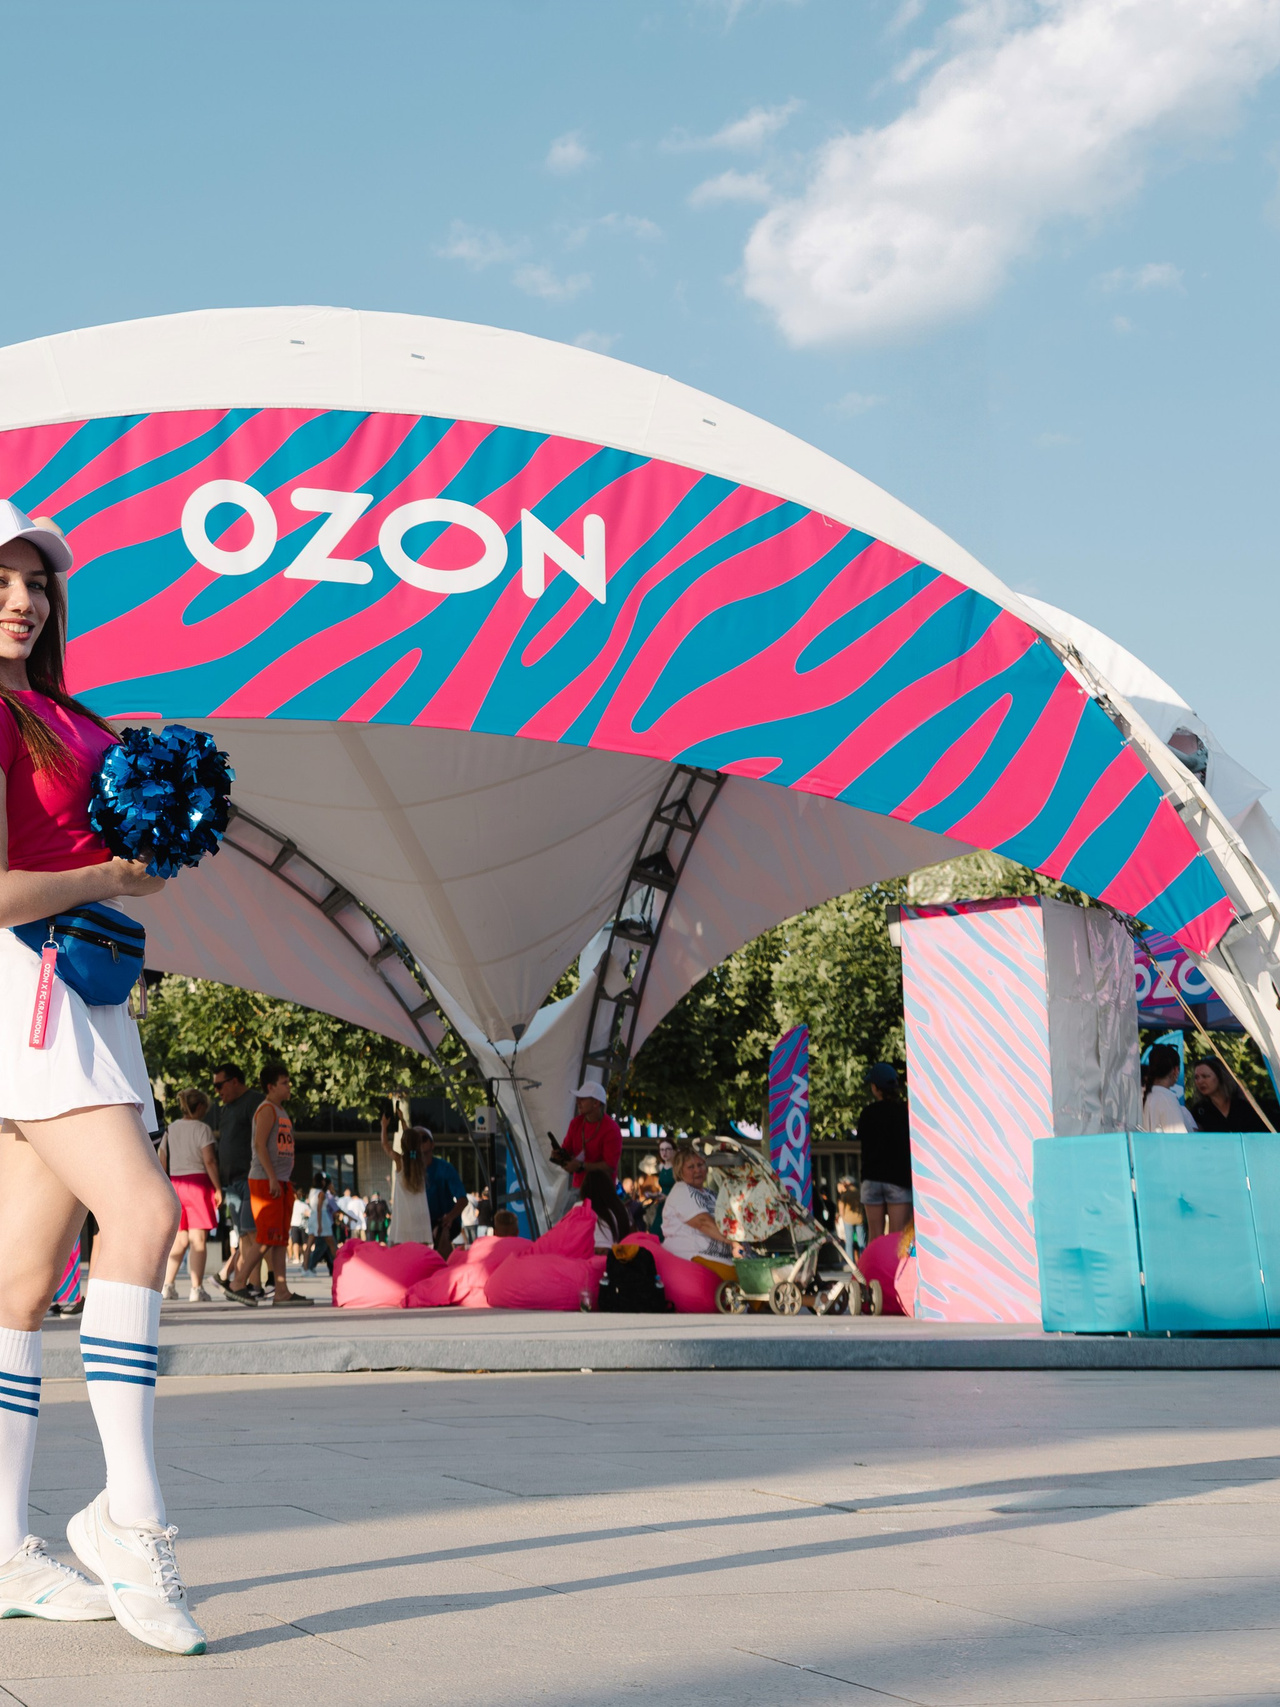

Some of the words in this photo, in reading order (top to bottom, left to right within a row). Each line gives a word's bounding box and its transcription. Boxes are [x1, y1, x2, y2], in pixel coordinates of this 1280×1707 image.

[181, 479, 606, 605] OZON
[42, 963, 51, 983] OZON
[1135, 958, 1211, 1001] OZO
[39, 990, 47, 1000] FC
[32, 1000, 45, 1045] KRASNODAR
